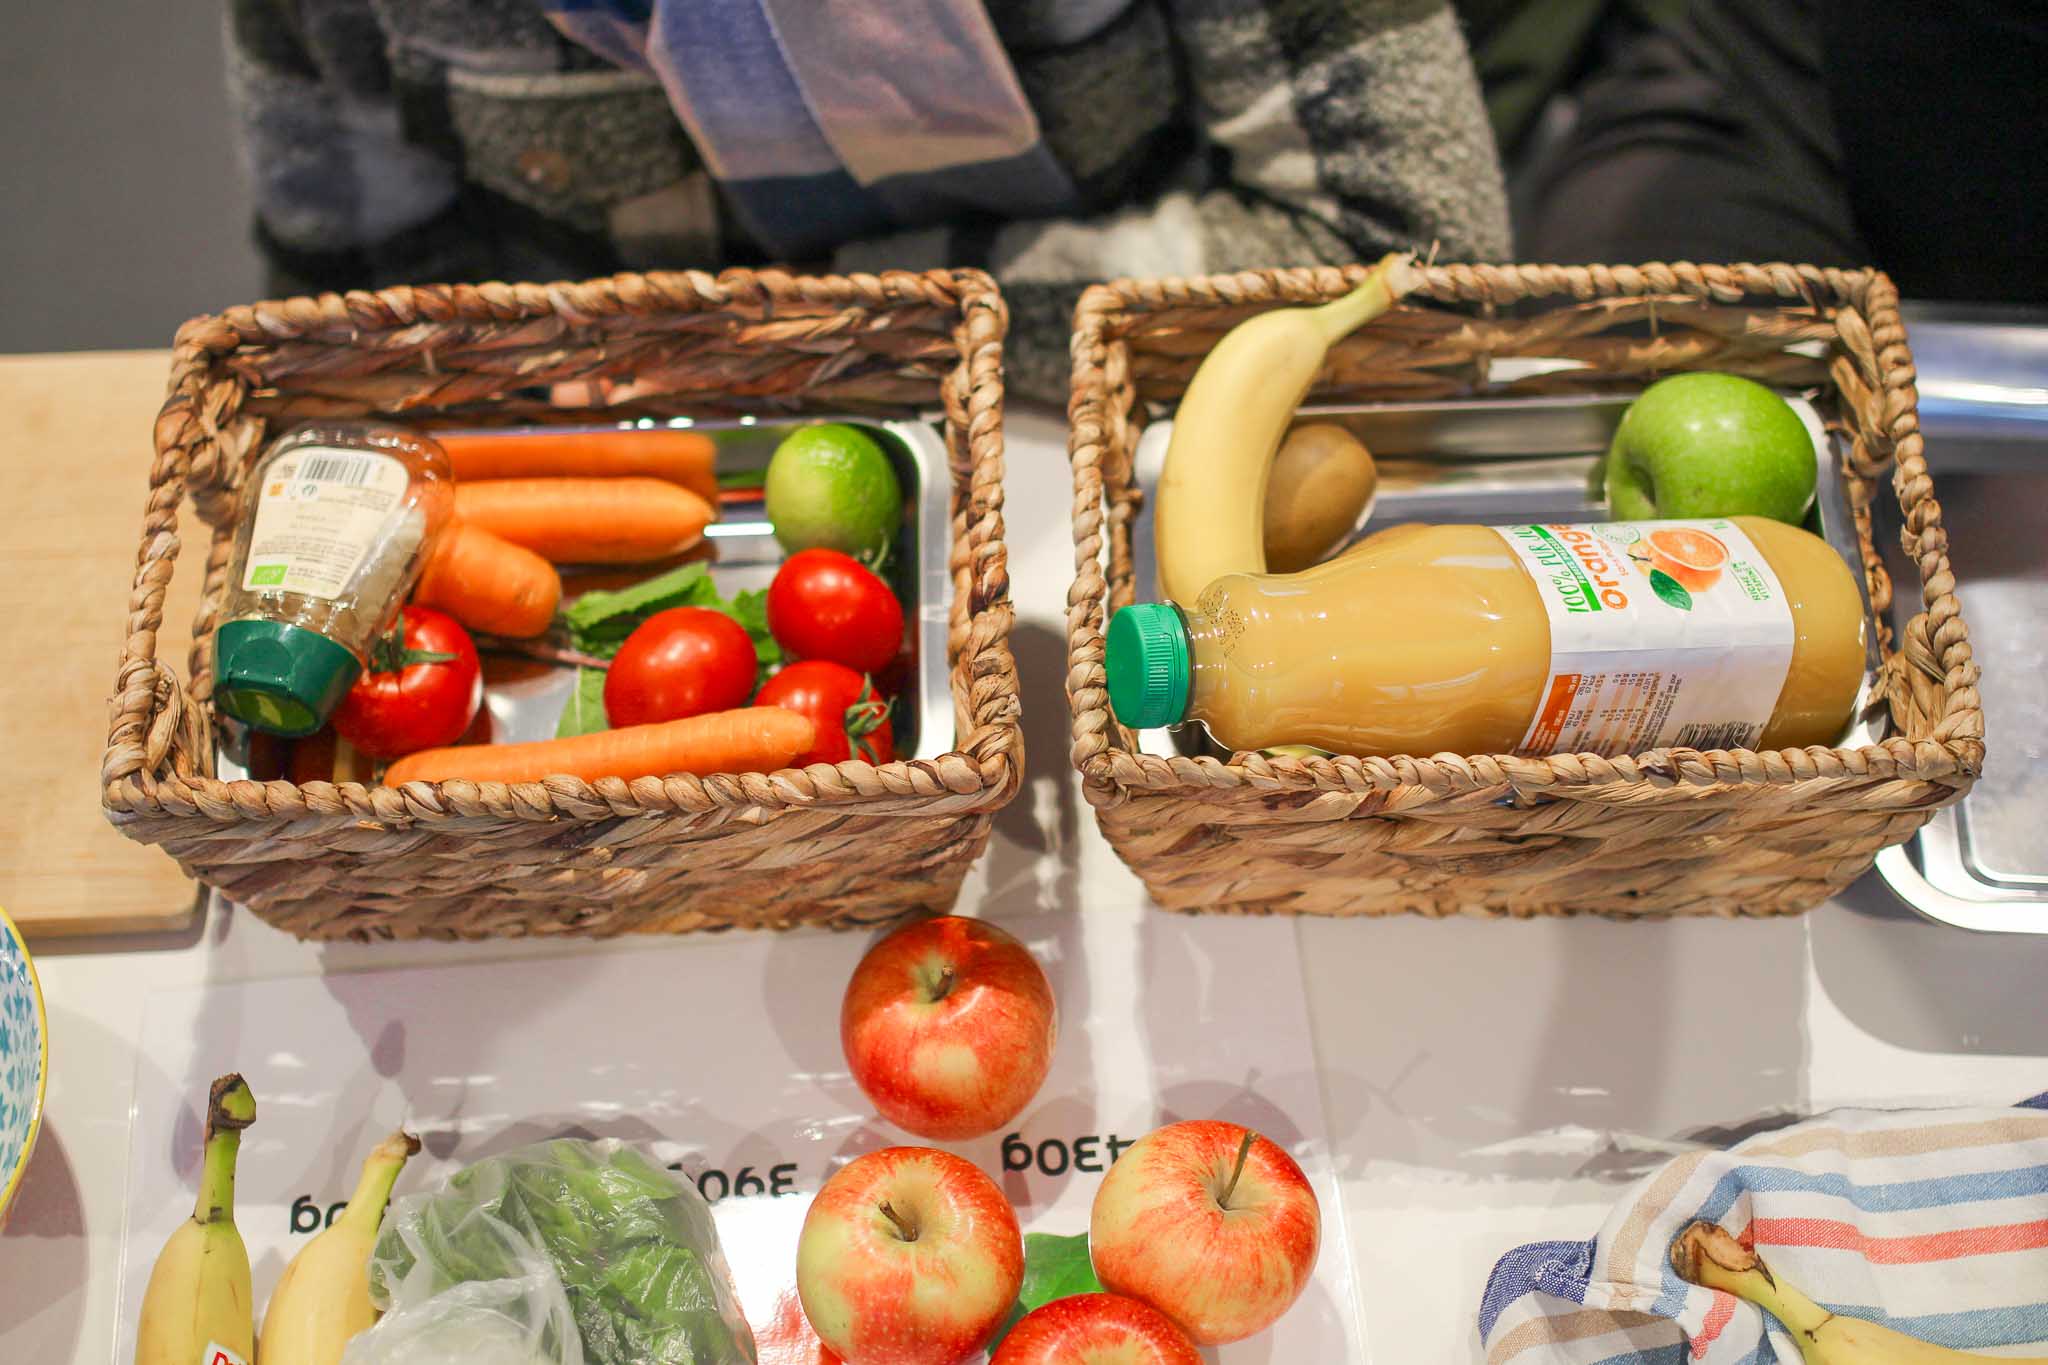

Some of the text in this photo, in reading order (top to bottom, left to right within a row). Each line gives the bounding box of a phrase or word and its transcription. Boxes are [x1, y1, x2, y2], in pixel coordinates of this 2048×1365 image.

[1528, 543, 1564, 566] PUR
[1547, 524, 1628, 609] orange
[1548, 570, 1589, 613] 100%
[1741, 576, 1760, 600] RICHE
[667, 1162, 798, 1205] 390
